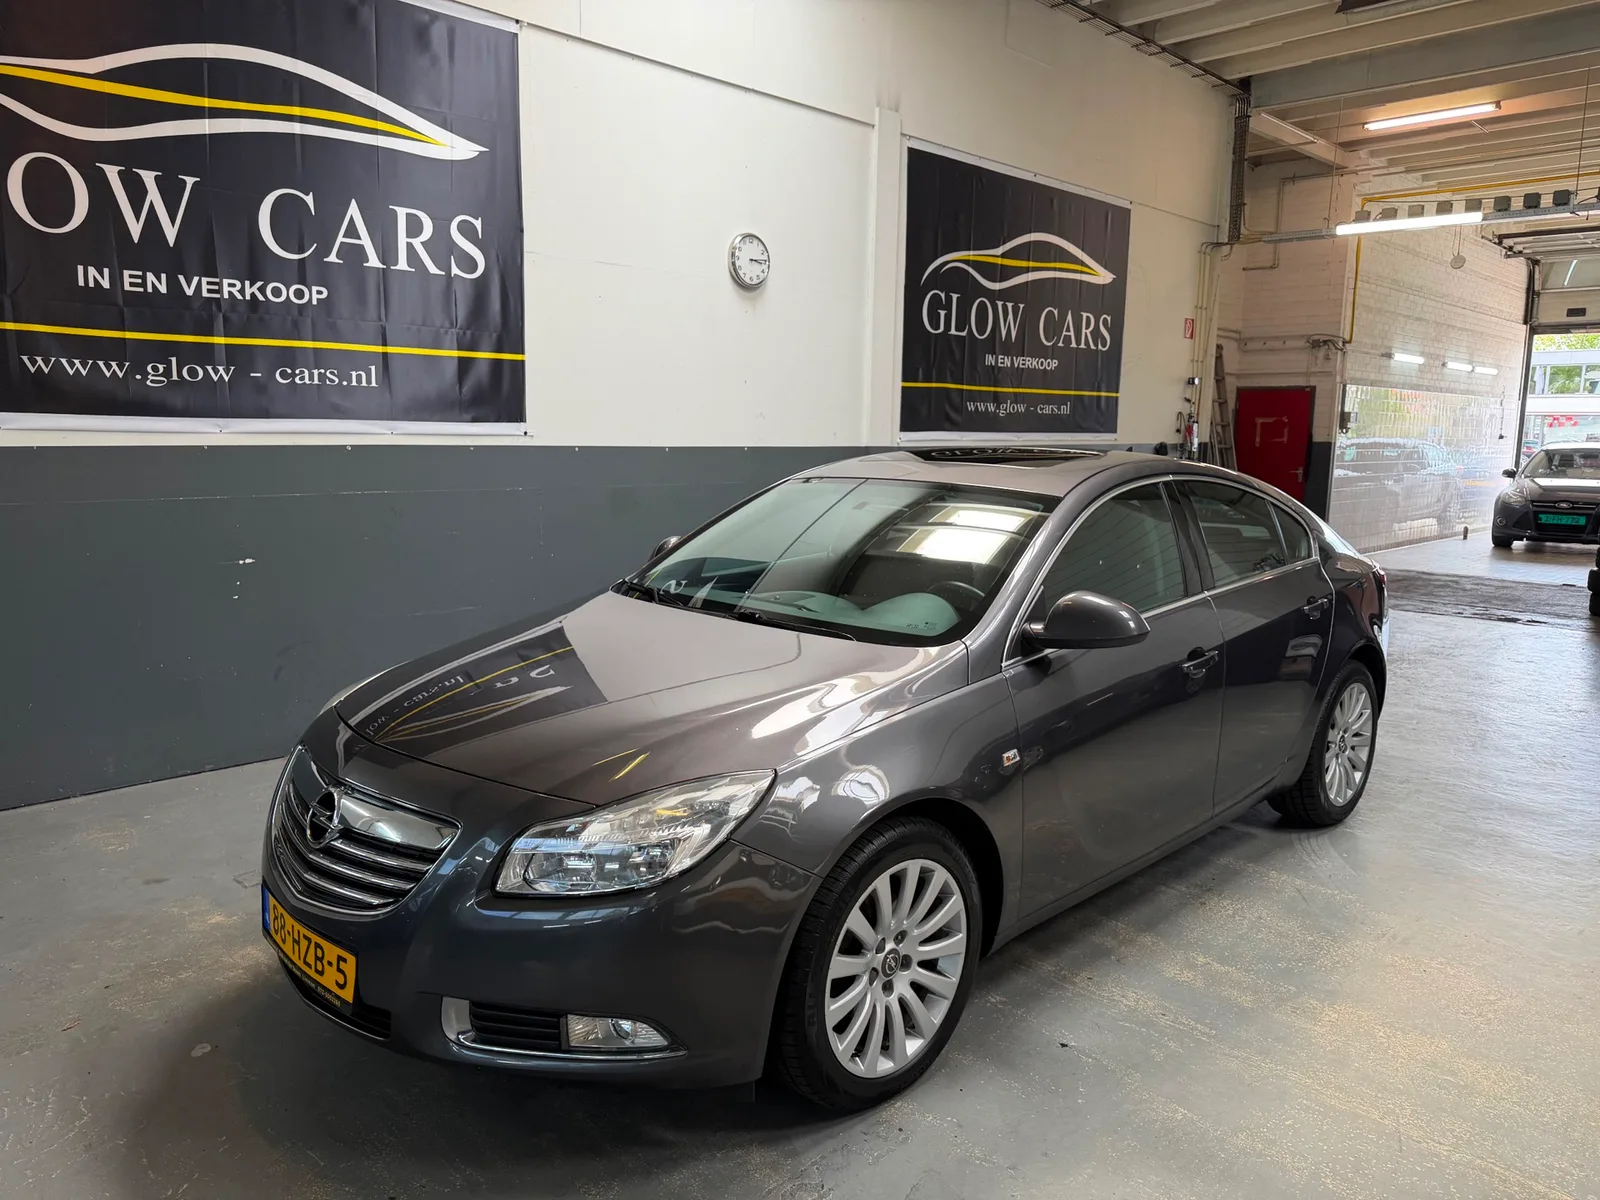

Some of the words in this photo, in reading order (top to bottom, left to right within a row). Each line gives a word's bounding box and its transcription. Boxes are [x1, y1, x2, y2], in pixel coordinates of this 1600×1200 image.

[6, 152, 200, 248] OW
[257, 188, 486, 279] CARS
[77, 264, 110, 289] IN
[123, 269, 168, 294] EN
[178, 274, 329, 306] VERKOOP
[922, 289, 1025, 343] GLOW
[1039, 306, 1112, 351] CARS
[20, 354, 235, 388] www.glow
[275, 365, 379, 388] cars.nl
[985, 354, 996, 366] IN
[998, 355, 1011, 368] EN
[1013, 356, 1059, 370] VERKOOP
[967, 400, 1027, 417] www.glow
[1037, 401, 1070, 415] cars.nl
[272, 903, 348, 990] 88-HZB-5
